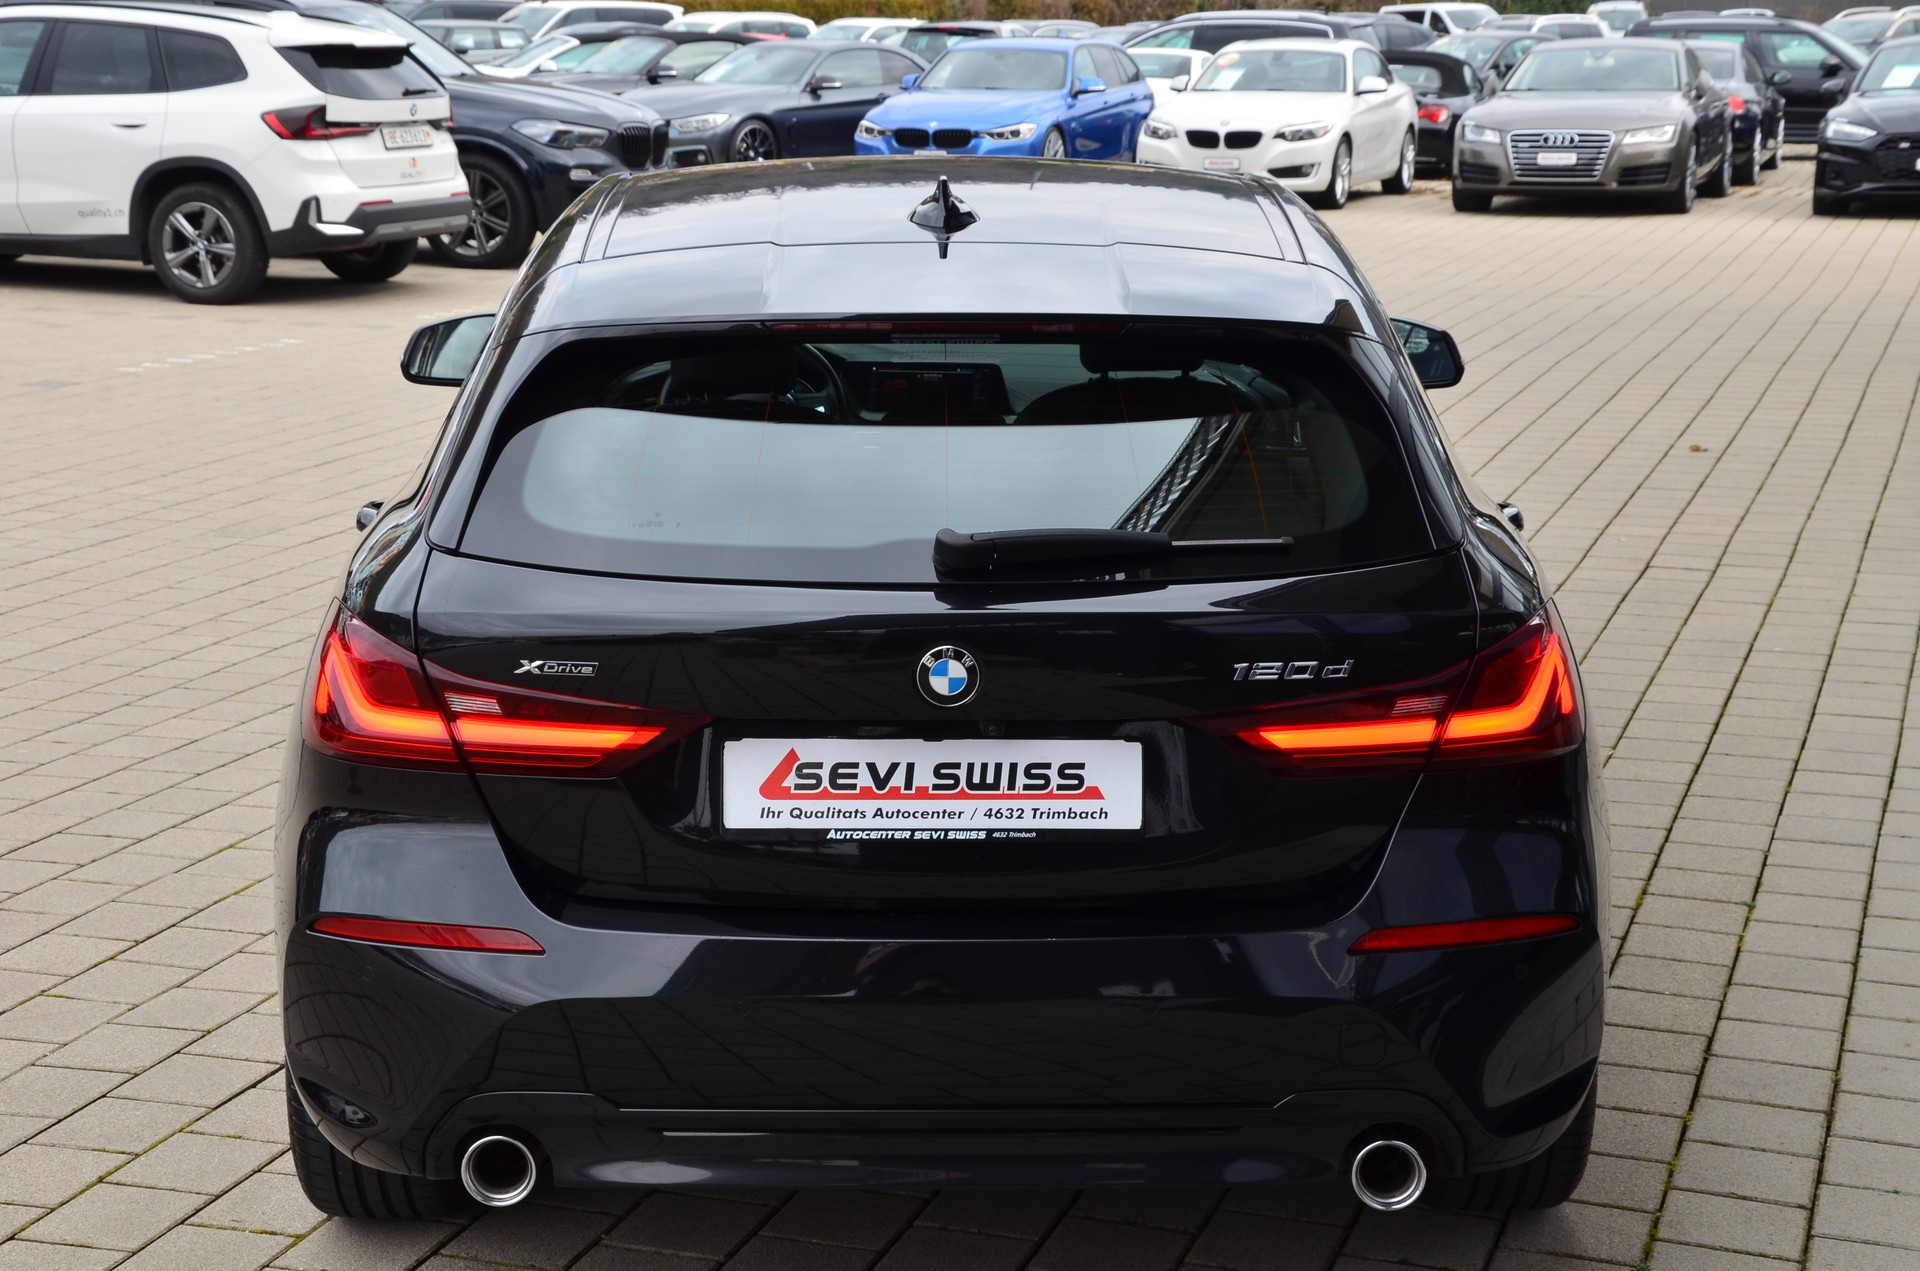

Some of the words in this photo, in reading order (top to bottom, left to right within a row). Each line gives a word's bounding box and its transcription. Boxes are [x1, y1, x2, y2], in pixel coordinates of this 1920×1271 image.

[922, 647, 974, 668] BMW
[793, 761, 916, 792] SEVI
[931, 761, 1086, 792] SWISS
[760, 806, 784, 819] Ihr
[789, 806, 867, 820] Qualitats
[872, 807, 965, 820] Autocenter
[969, 807, 978, 821] /
[983, 807, 1025, 820] 4632
[1031, 807, 1109, 820] Trimbach
[913, 830, 945, 840] SEVI
[946, 830, 987, 840] SWISS
